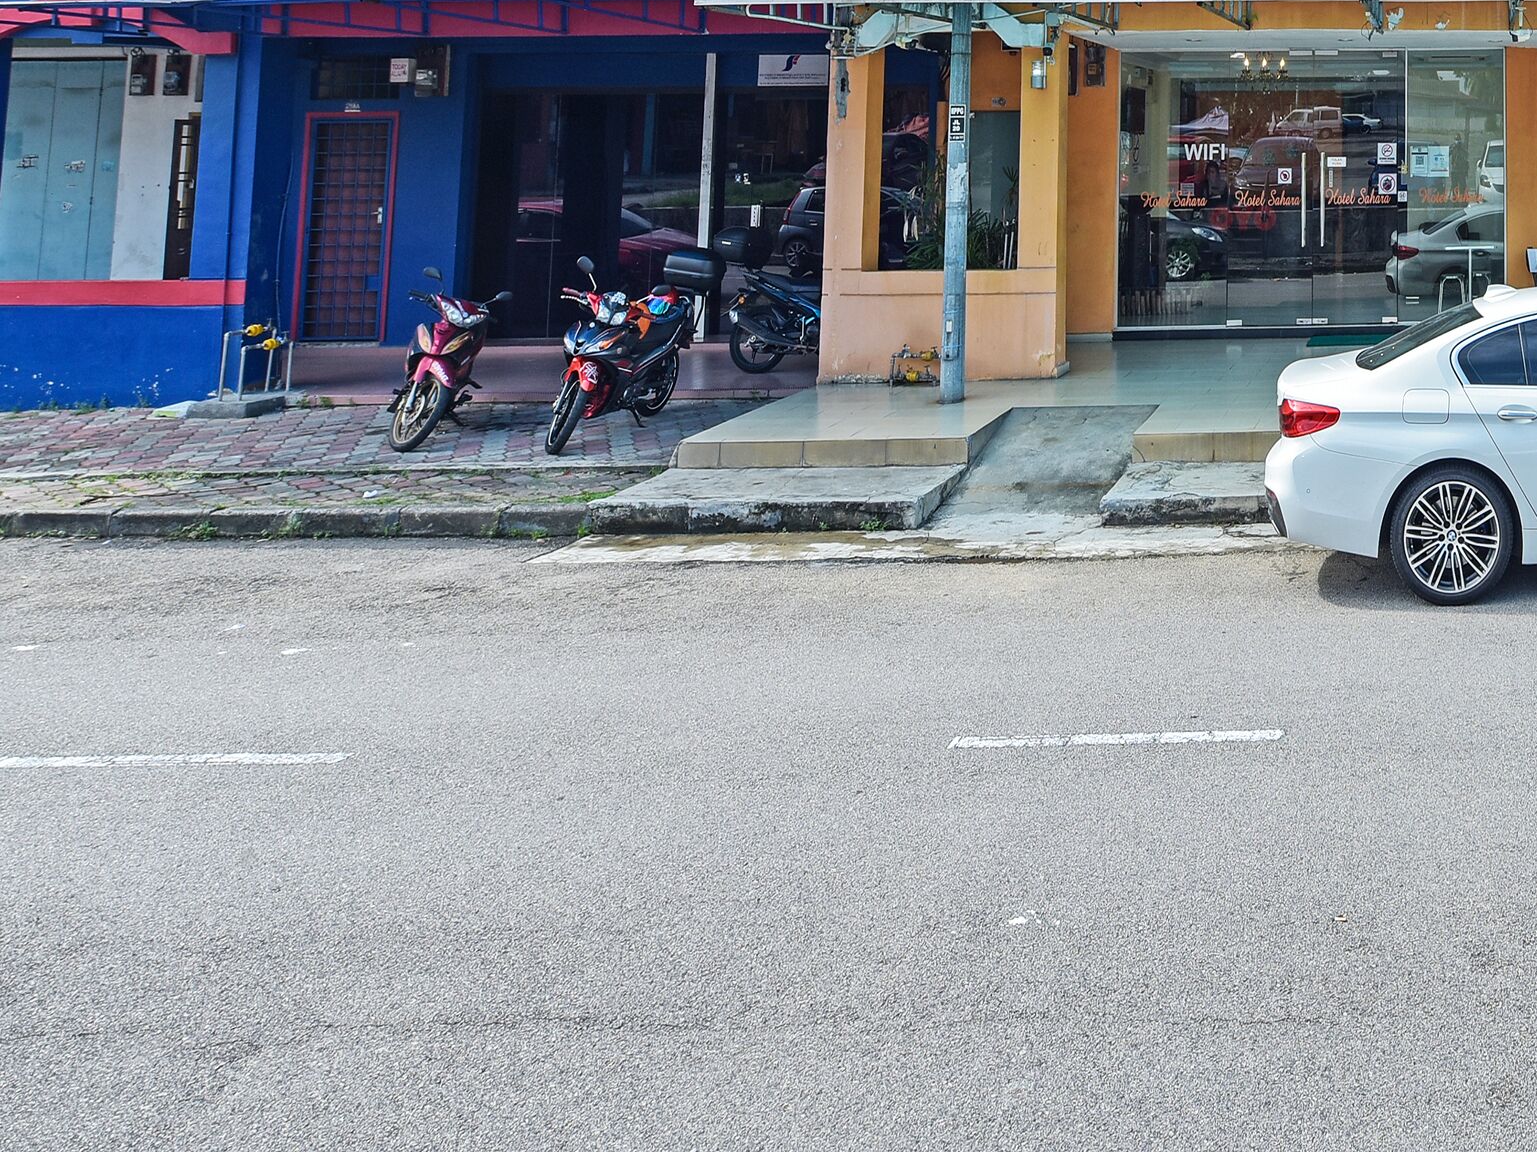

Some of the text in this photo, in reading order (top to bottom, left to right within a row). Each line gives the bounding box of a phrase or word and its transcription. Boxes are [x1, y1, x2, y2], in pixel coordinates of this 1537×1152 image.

[1184, 143, 1226, 161] WIFI
[1141, 190, 1208, 208] Hotel Sahara
[1235, 188, 1302, 207] Hotel Sahara
[1326, 187, 1356, 205] Hotel
[1357, 187, 1392, 205] Sahara
